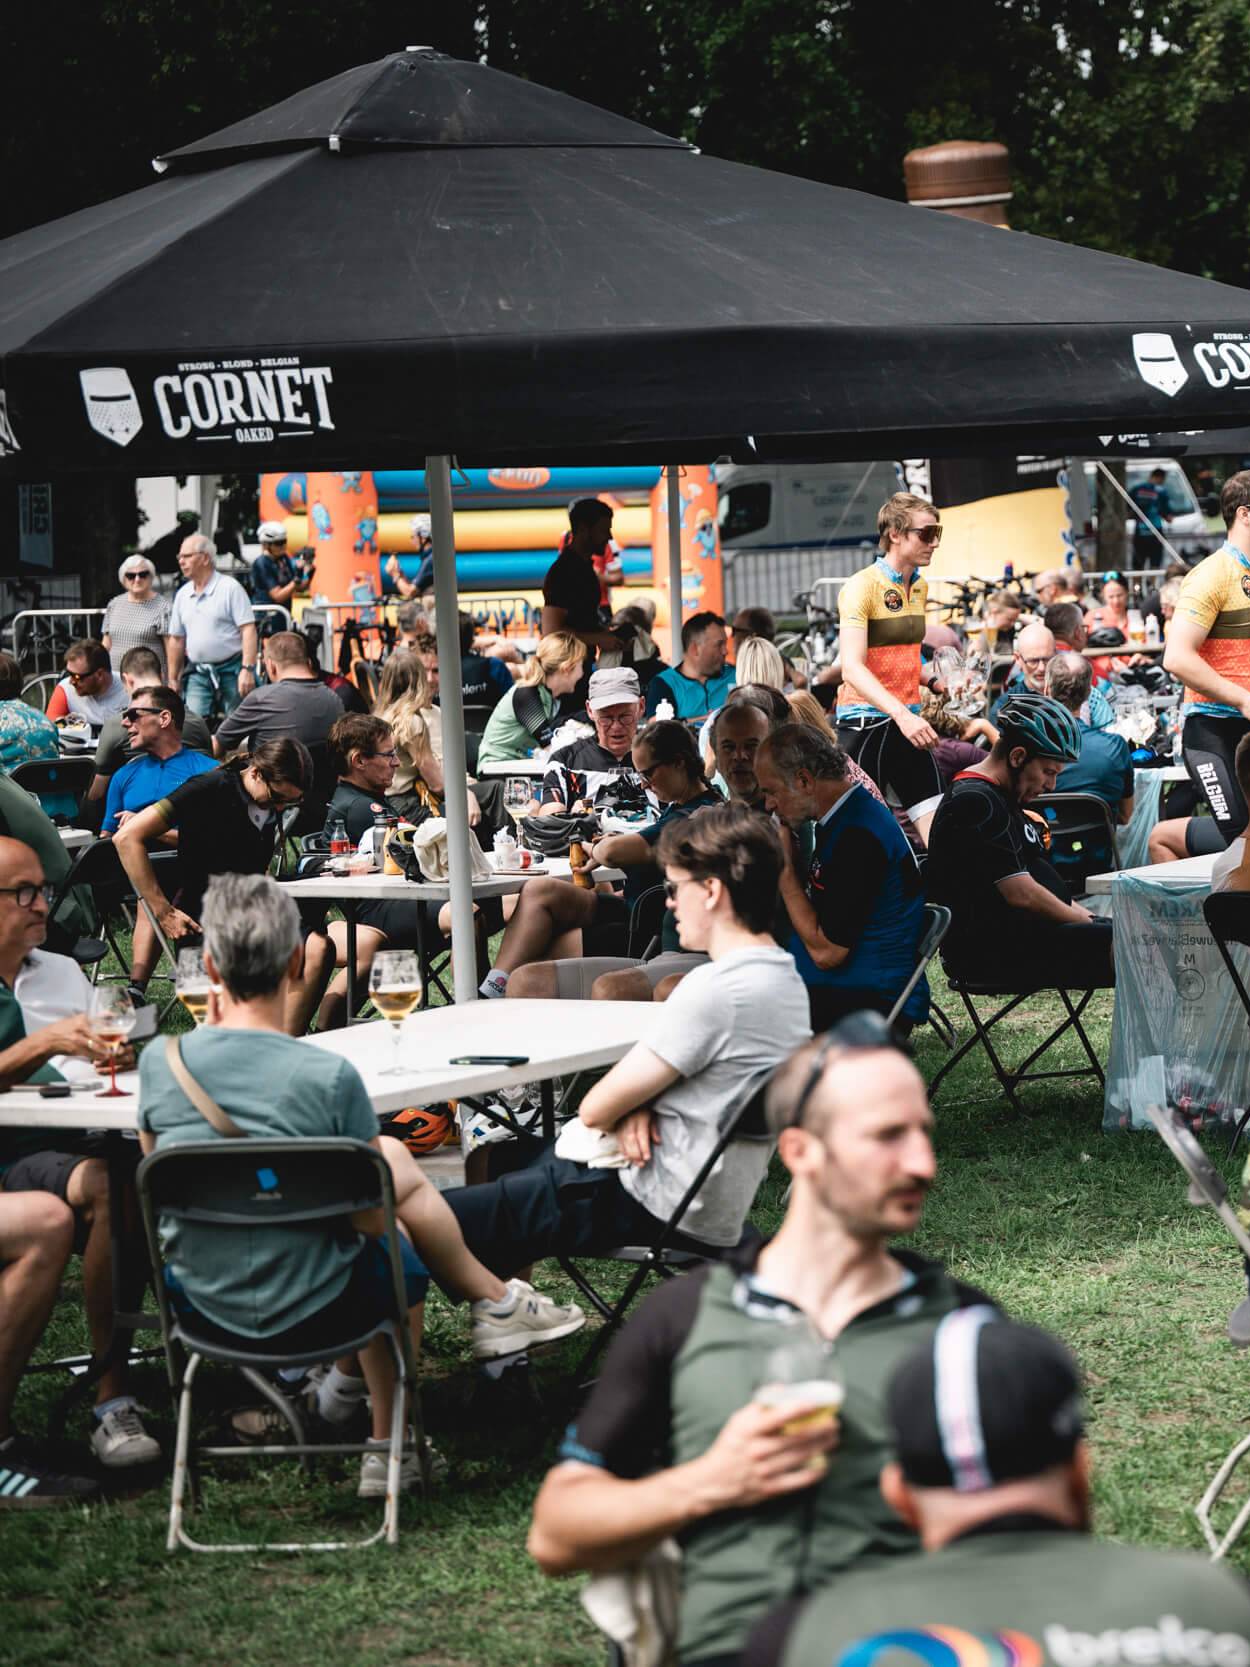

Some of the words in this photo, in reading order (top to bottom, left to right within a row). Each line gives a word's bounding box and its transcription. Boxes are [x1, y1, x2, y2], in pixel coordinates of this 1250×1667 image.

[177, 361, 216, 371] STRONG
[222, 359, 254, 369] BLOND
[260, 357, 300, 367] BELGIAN
[154, 367, 336, 439] CORNET
[235, 427, 274, 443] OAKED
[1196, 762, 1232, 821] BELGIUM
